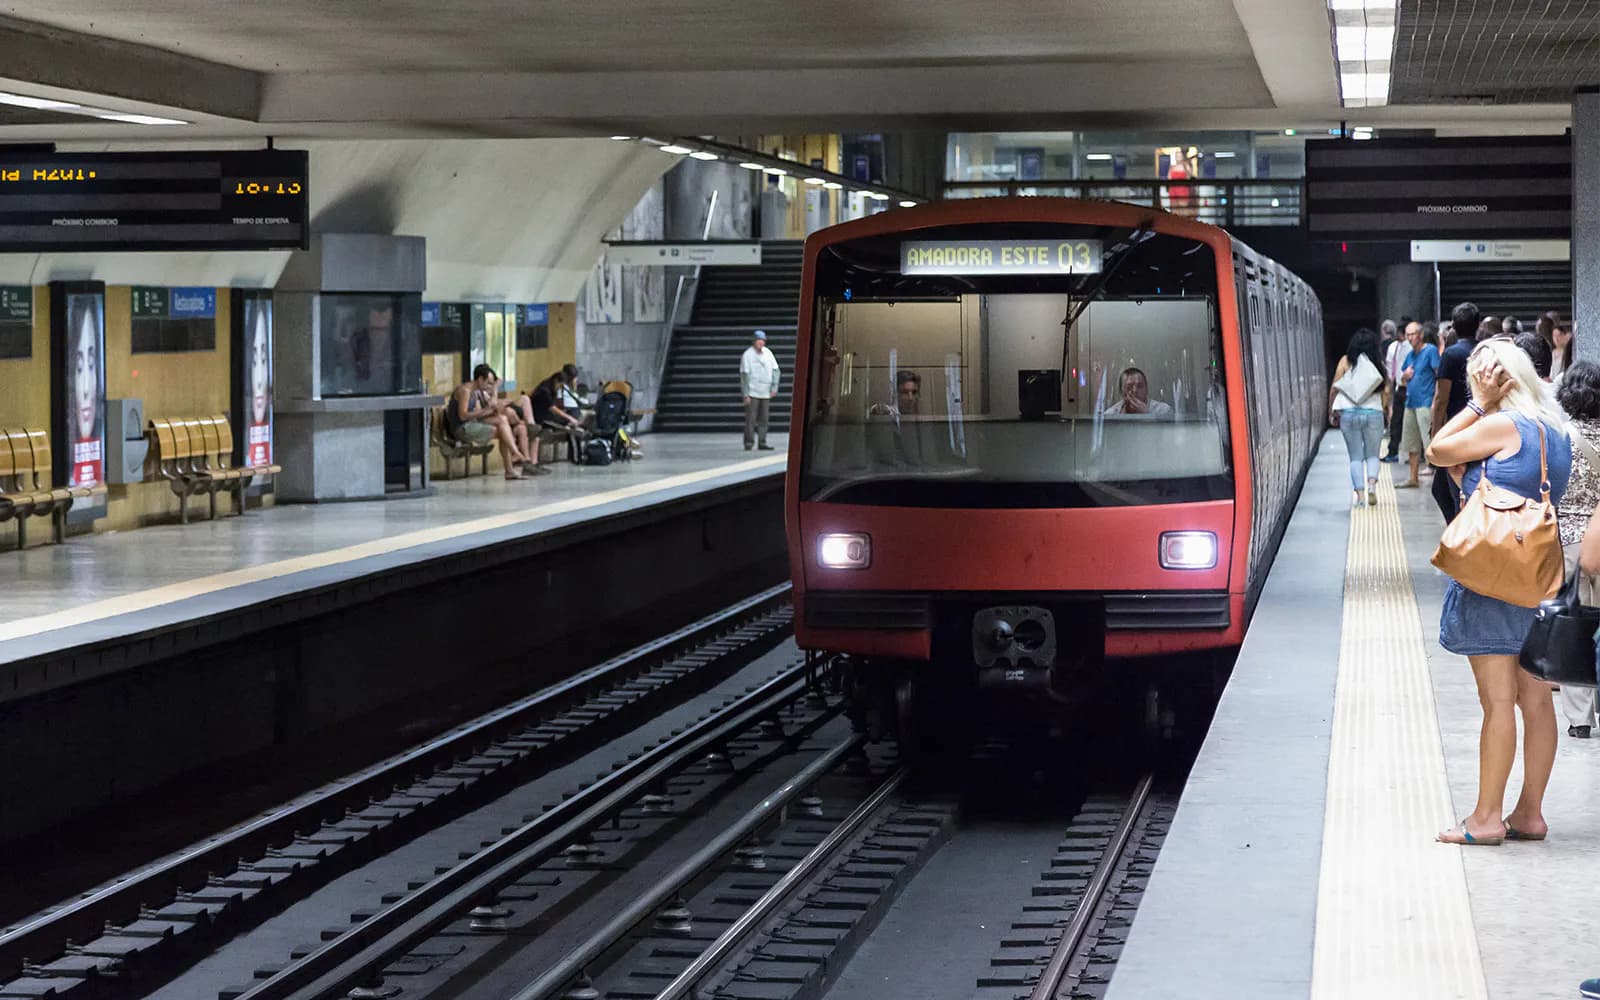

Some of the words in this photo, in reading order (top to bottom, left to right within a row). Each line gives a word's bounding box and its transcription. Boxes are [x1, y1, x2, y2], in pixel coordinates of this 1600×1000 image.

[1452, 204, 1488, 213] COMBOIO
[232, 217, 255, 225] TEMPO
[255, 217, 264, 225] DE
[906, 246, 993, 266] AMADORA
[1000, 246, 1049, 265] ESTE
[1057, 242, 1091, 270] 03
